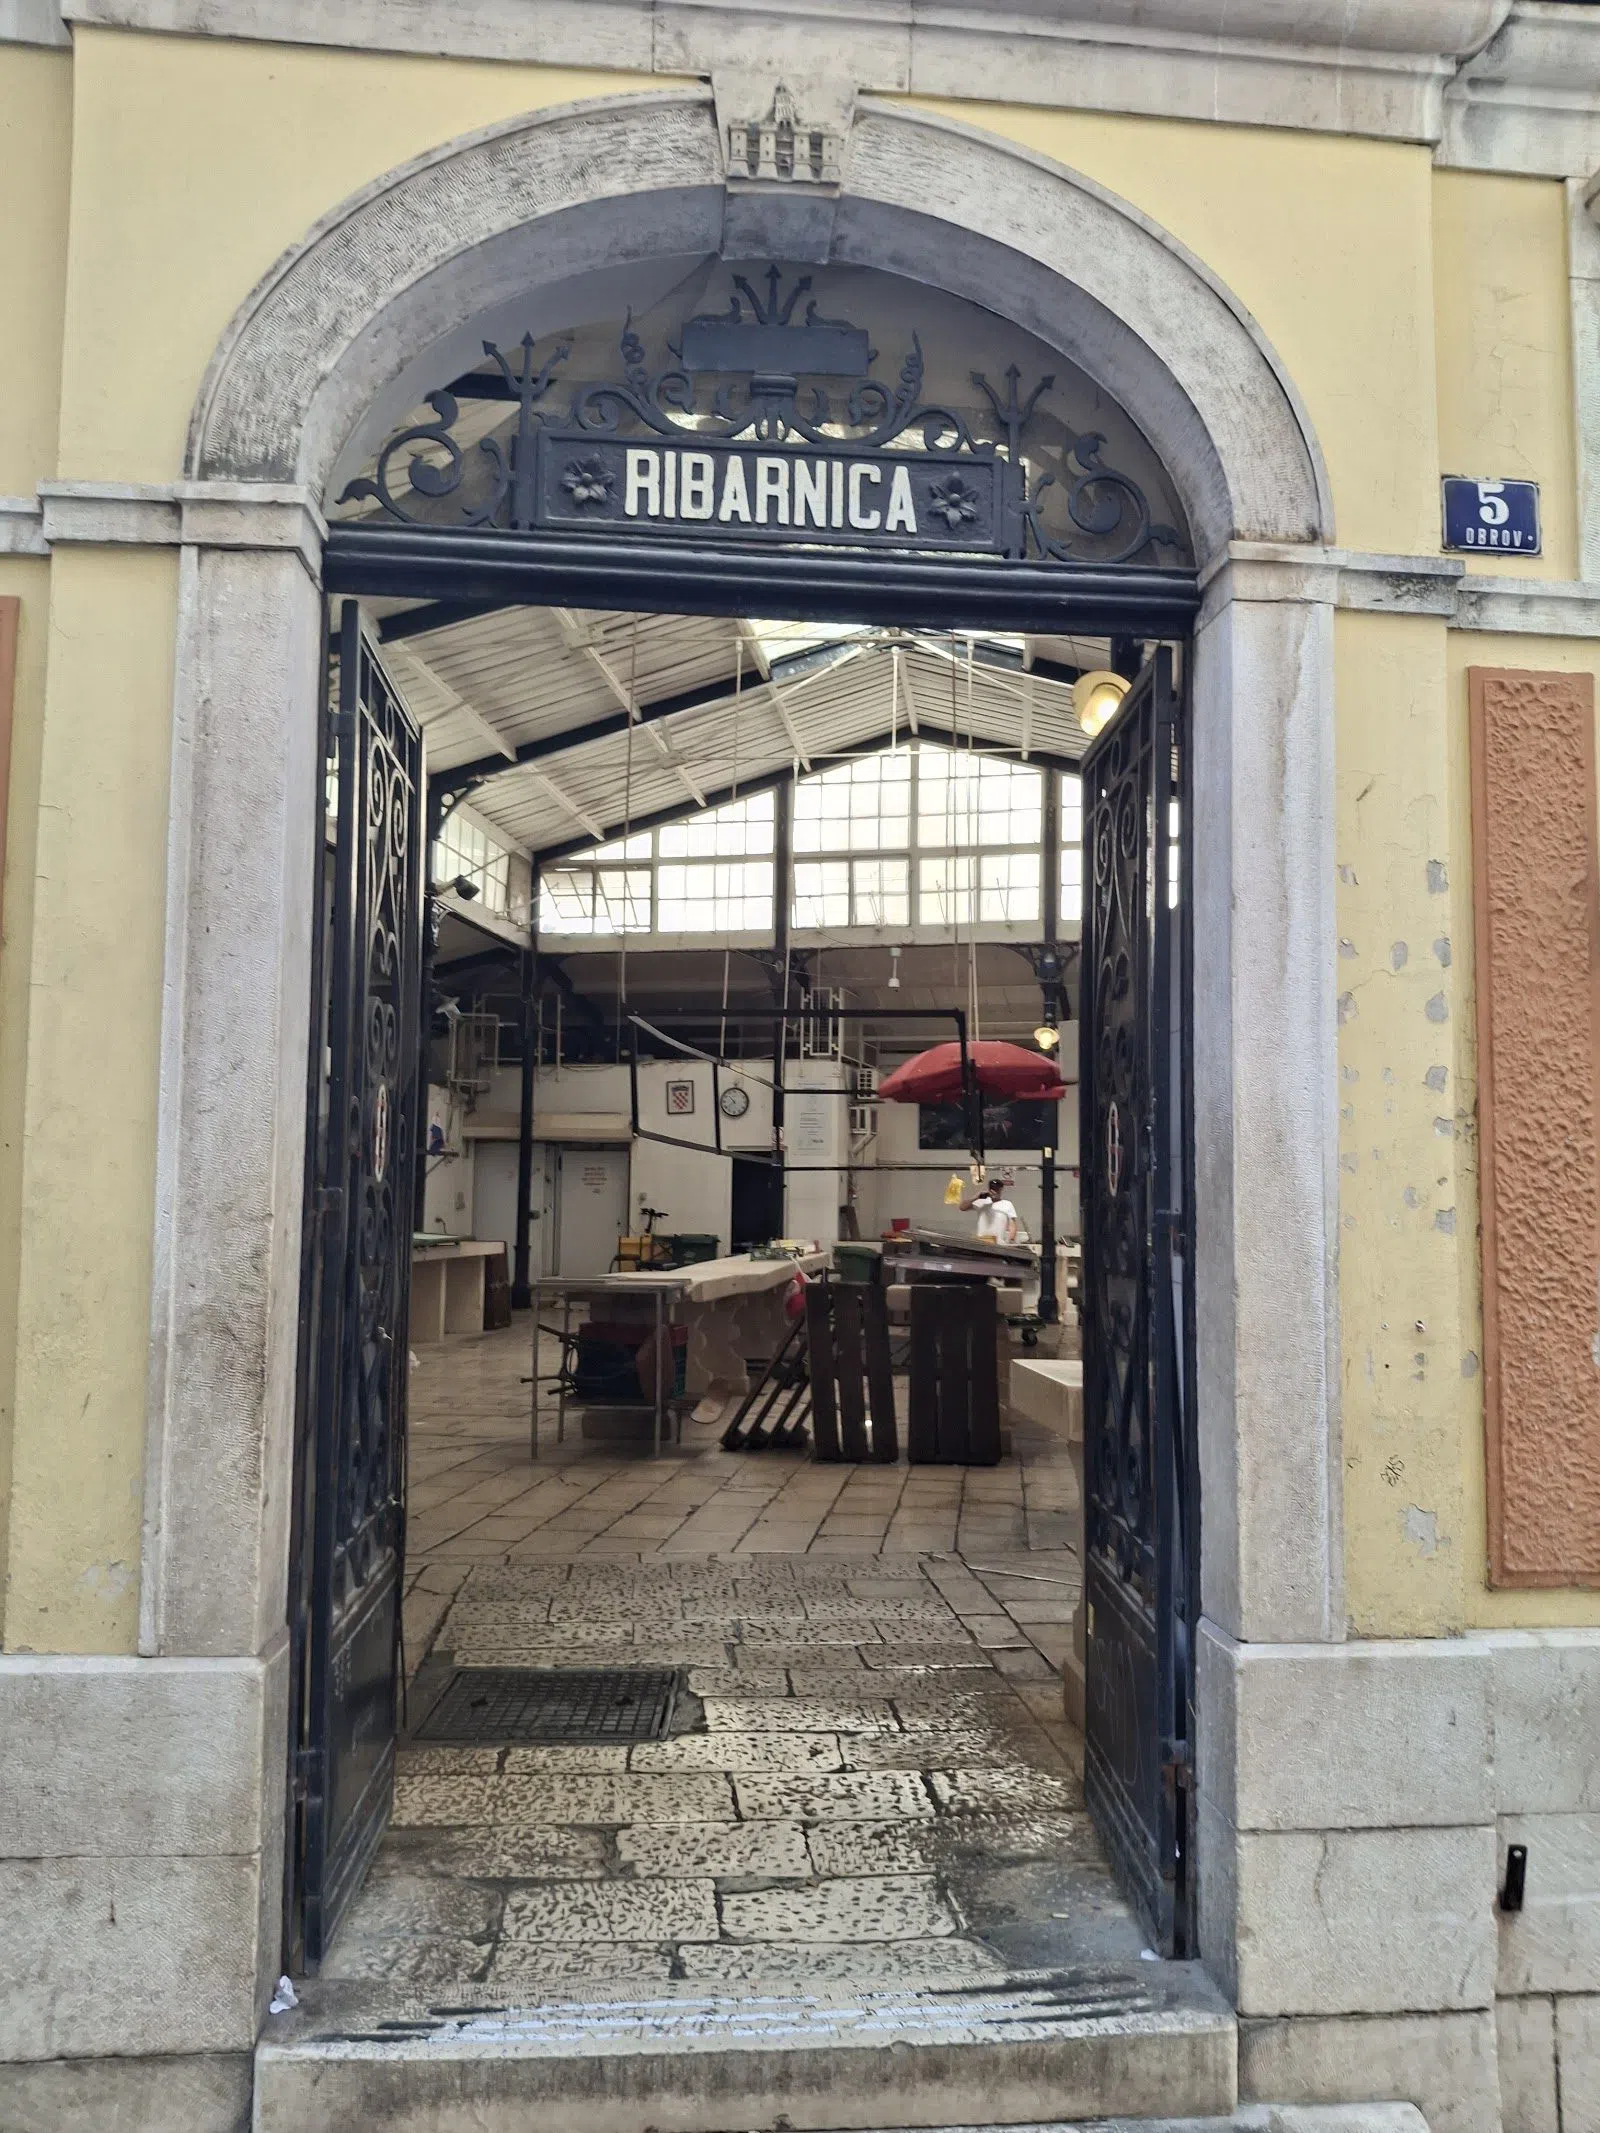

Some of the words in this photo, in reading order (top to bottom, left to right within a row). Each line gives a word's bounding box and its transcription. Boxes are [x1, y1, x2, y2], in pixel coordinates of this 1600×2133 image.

[624, 448, 918, 533] RIBARNICA
[1477, 482, 1510, 525] 5
[1465, 527, 1523, 547] OBROV
